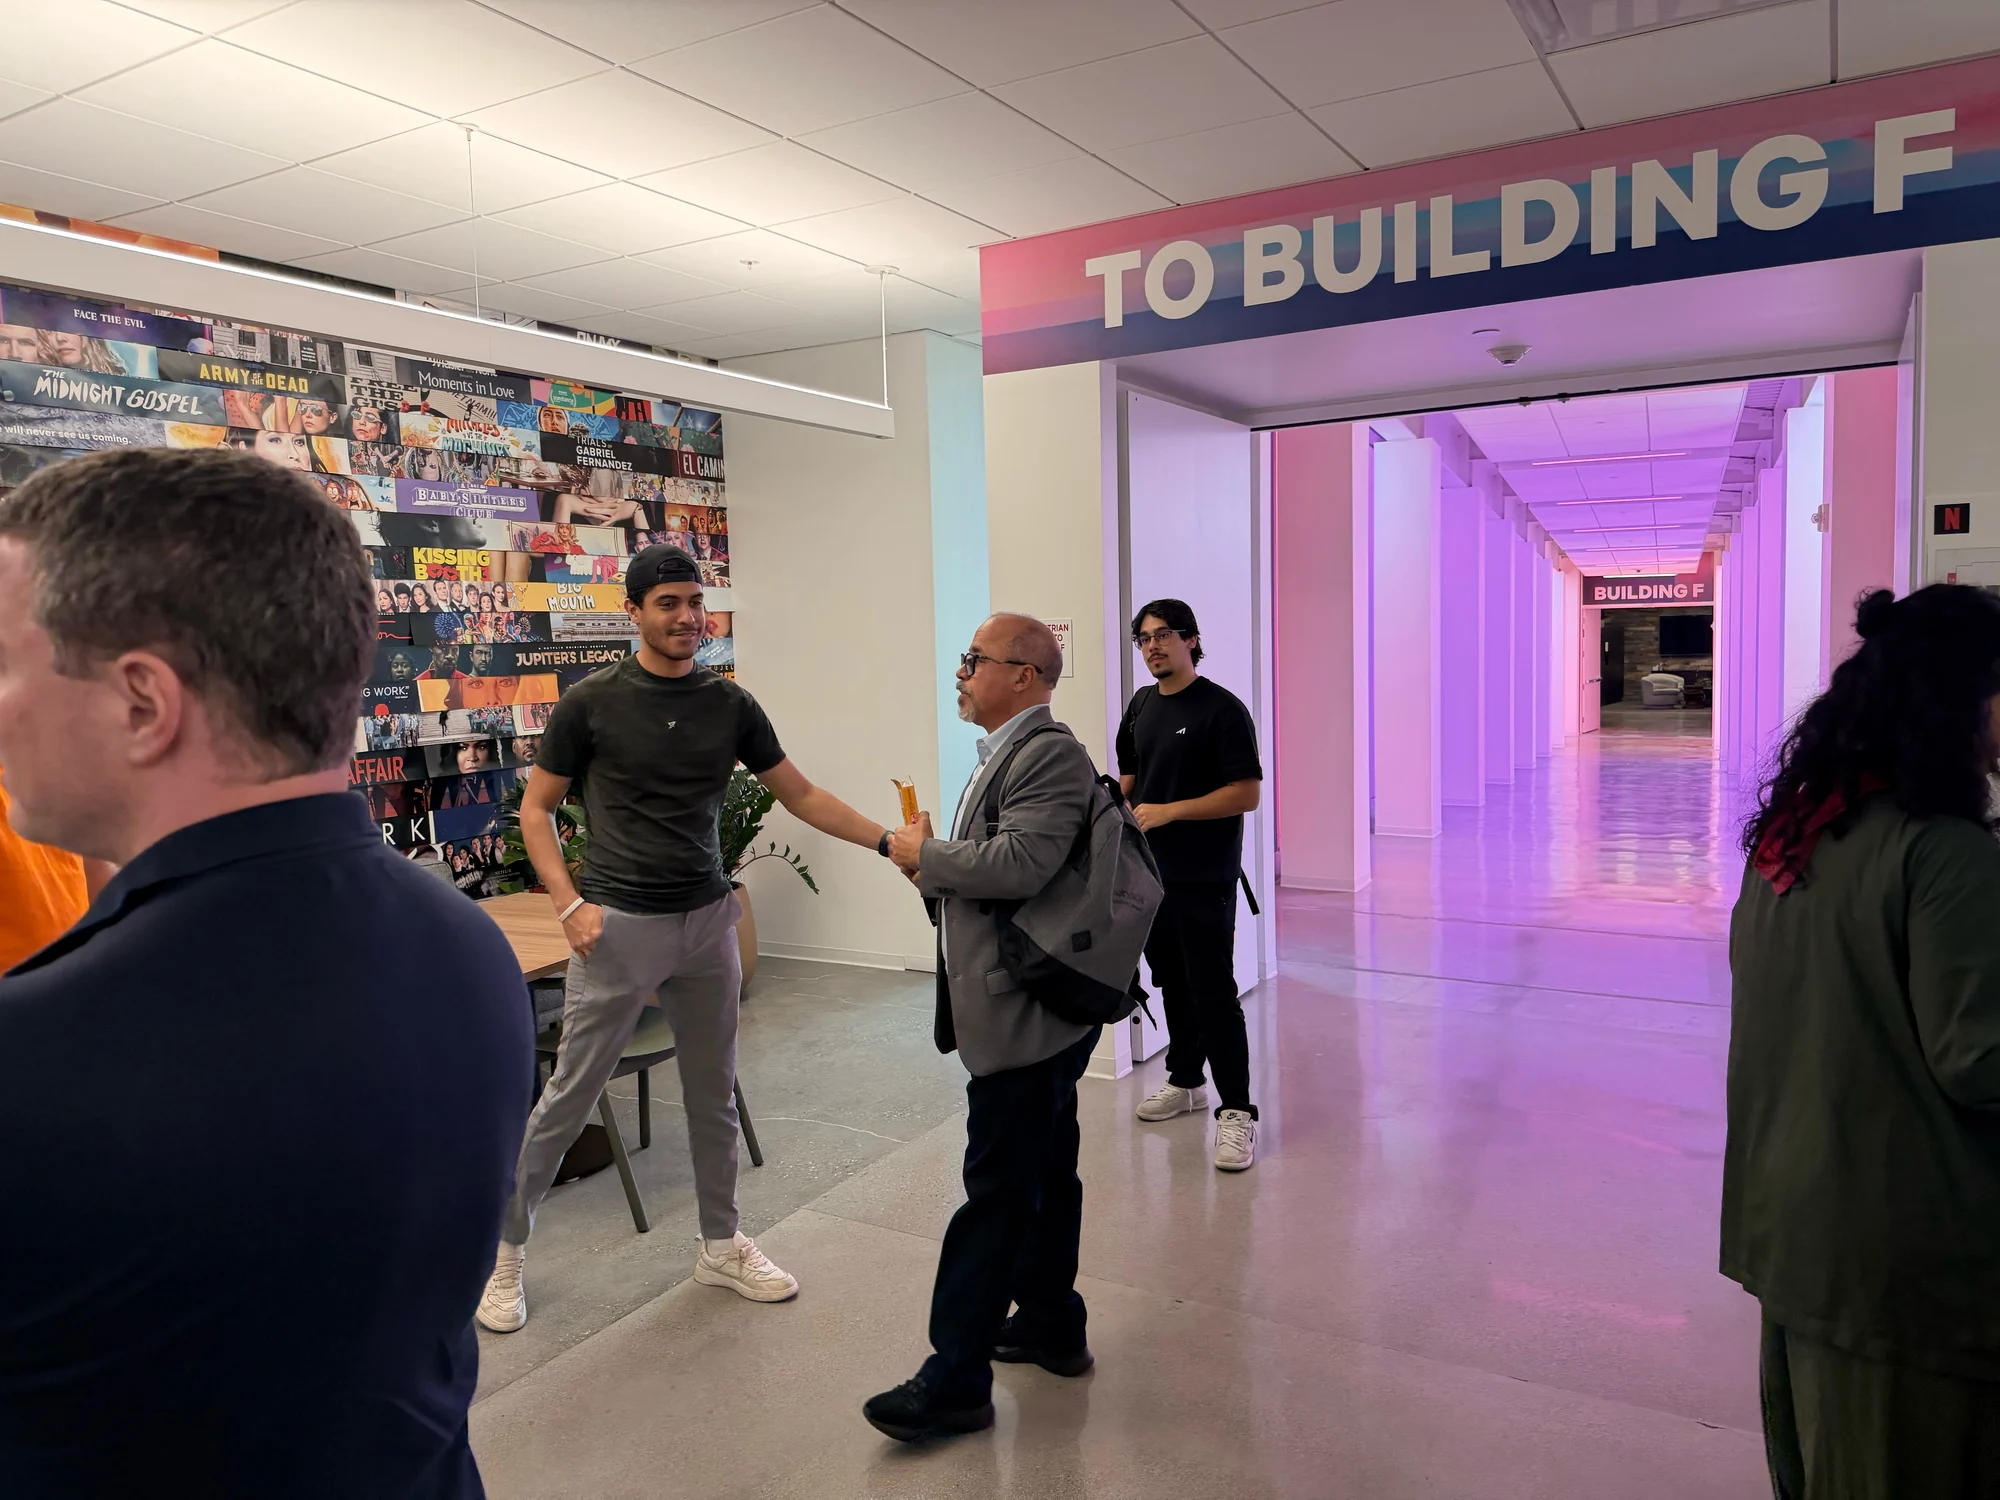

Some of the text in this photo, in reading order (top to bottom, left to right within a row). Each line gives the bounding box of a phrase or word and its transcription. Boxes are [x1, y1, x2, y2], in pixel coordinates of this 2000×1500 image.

[1085, 107, 1957, 328] TO BUILDING F
[73, 308, 146, 329] FACE THE EVIL
[42, 369, 66, 379] THE
[200, 363, 250, 386] ARMY
[251, 377, 264, 386] THE
[265, 373, 309, 394] DEAD
[351, 384, 403, 401] THE
[417, 370, 515, 399] Moments in Love
[33, 376, 126, 406] MIDNIGHT
[126, 388, 203, 416] GOSPEL
[5, 425, 23, 436] will
[25, 428, 57, 438] never
[59, 430, 76, 439] see
[79, 431, 90, 440] us
[92, 433, 132, 445] coming.
[577, 436, 607, 448] TRIALS
[576, 445, 616, 460] GABRIEL
[577, 456, 633, 471] FERNANDEZ
[683, 453, 696, 476] EL
[455, 507, 493, 519] CLUB
[1944, 507, 1960, 531] N
[413, 547, 490, 566] KISSING
[557, 583, 582, 594] BIG
[1594, 583, 1705, 600] BUILDING F
[547, 595, 595, 611] MOUTH
[516, 650, 626, 667] JUPITER'S LEGACY
